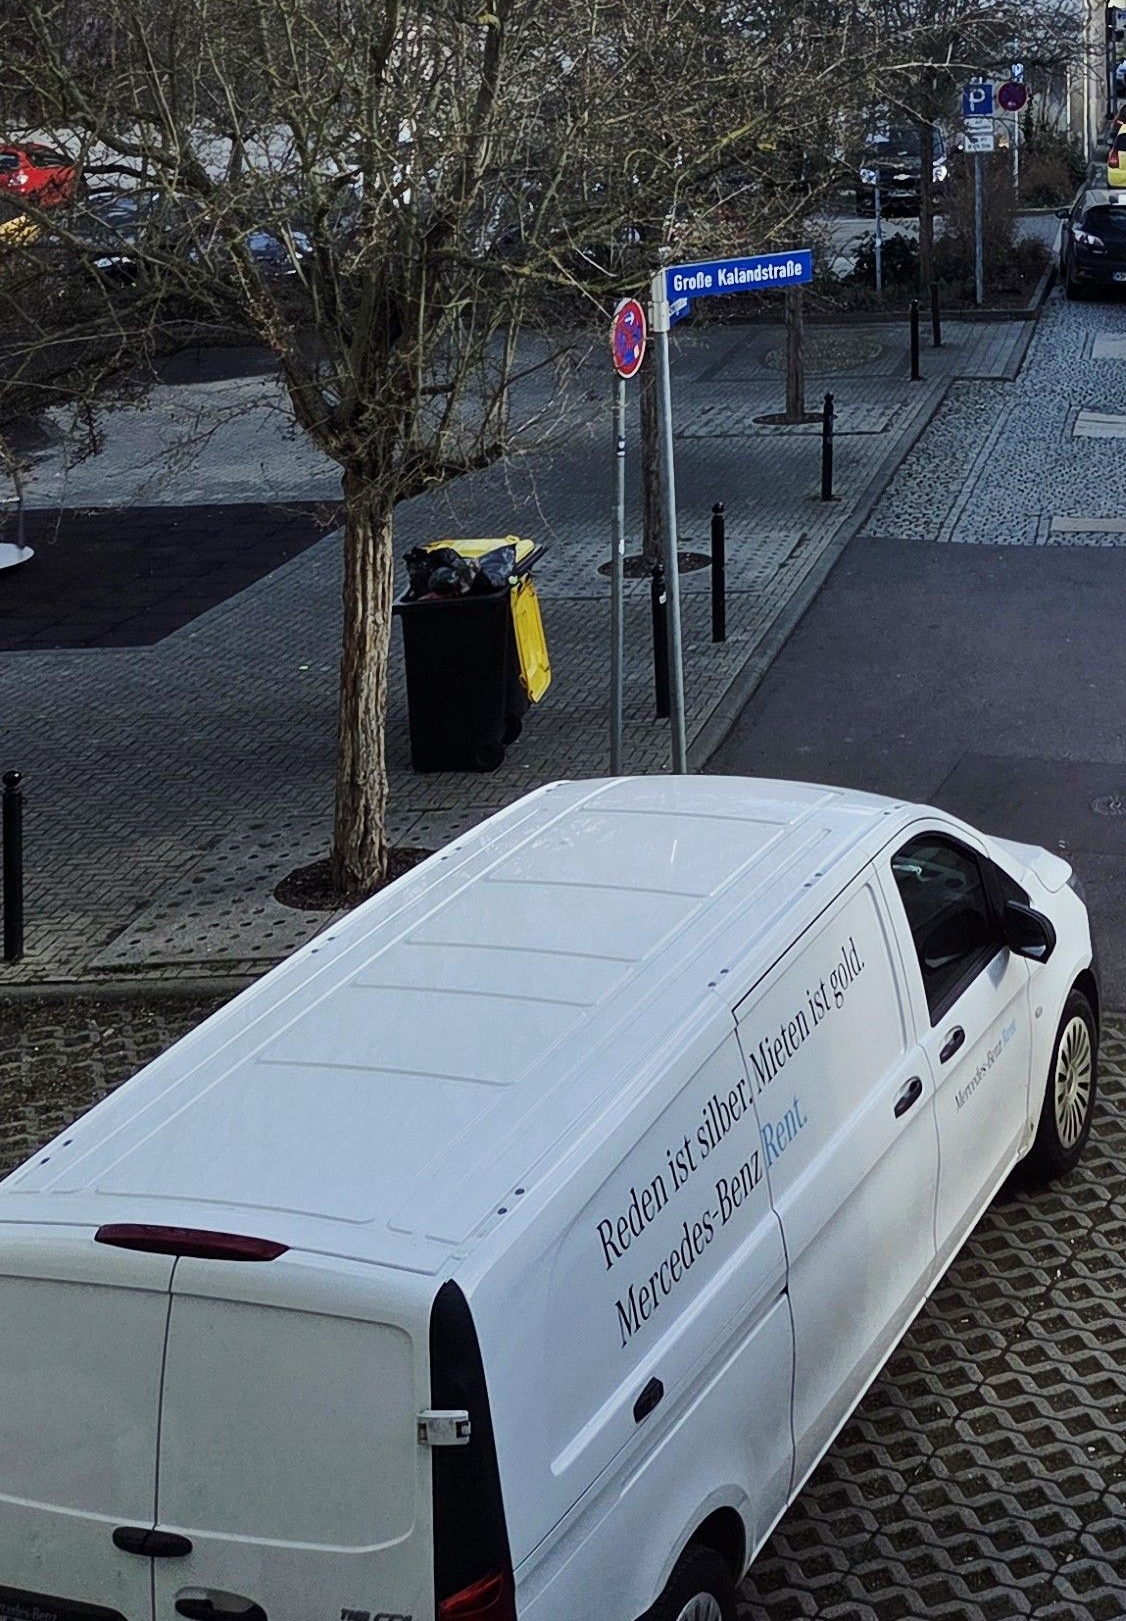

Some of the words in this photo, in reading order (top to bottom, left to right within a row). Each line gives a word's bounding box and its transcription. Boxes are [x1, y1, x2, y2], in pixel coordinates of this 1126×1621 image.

[969, 88, 986, 112] P
[673, 272, 712, 291] Große
[717, 260, 802, 286] Kalandstraße
[596, 1187, 669, 1271] Reden
[666, 1135, 698, 1192] ist
[696, 1079, 754, 1159] silber.
[749, 1010, 810, 1094] Mieten
[806, 979, 831, 1027] ist
[830, 936, 865, 1010] gold.
[614, 1150, 763, 1349] Mercedes-Benz
[761, 1097, 808, 1170] Rent.
